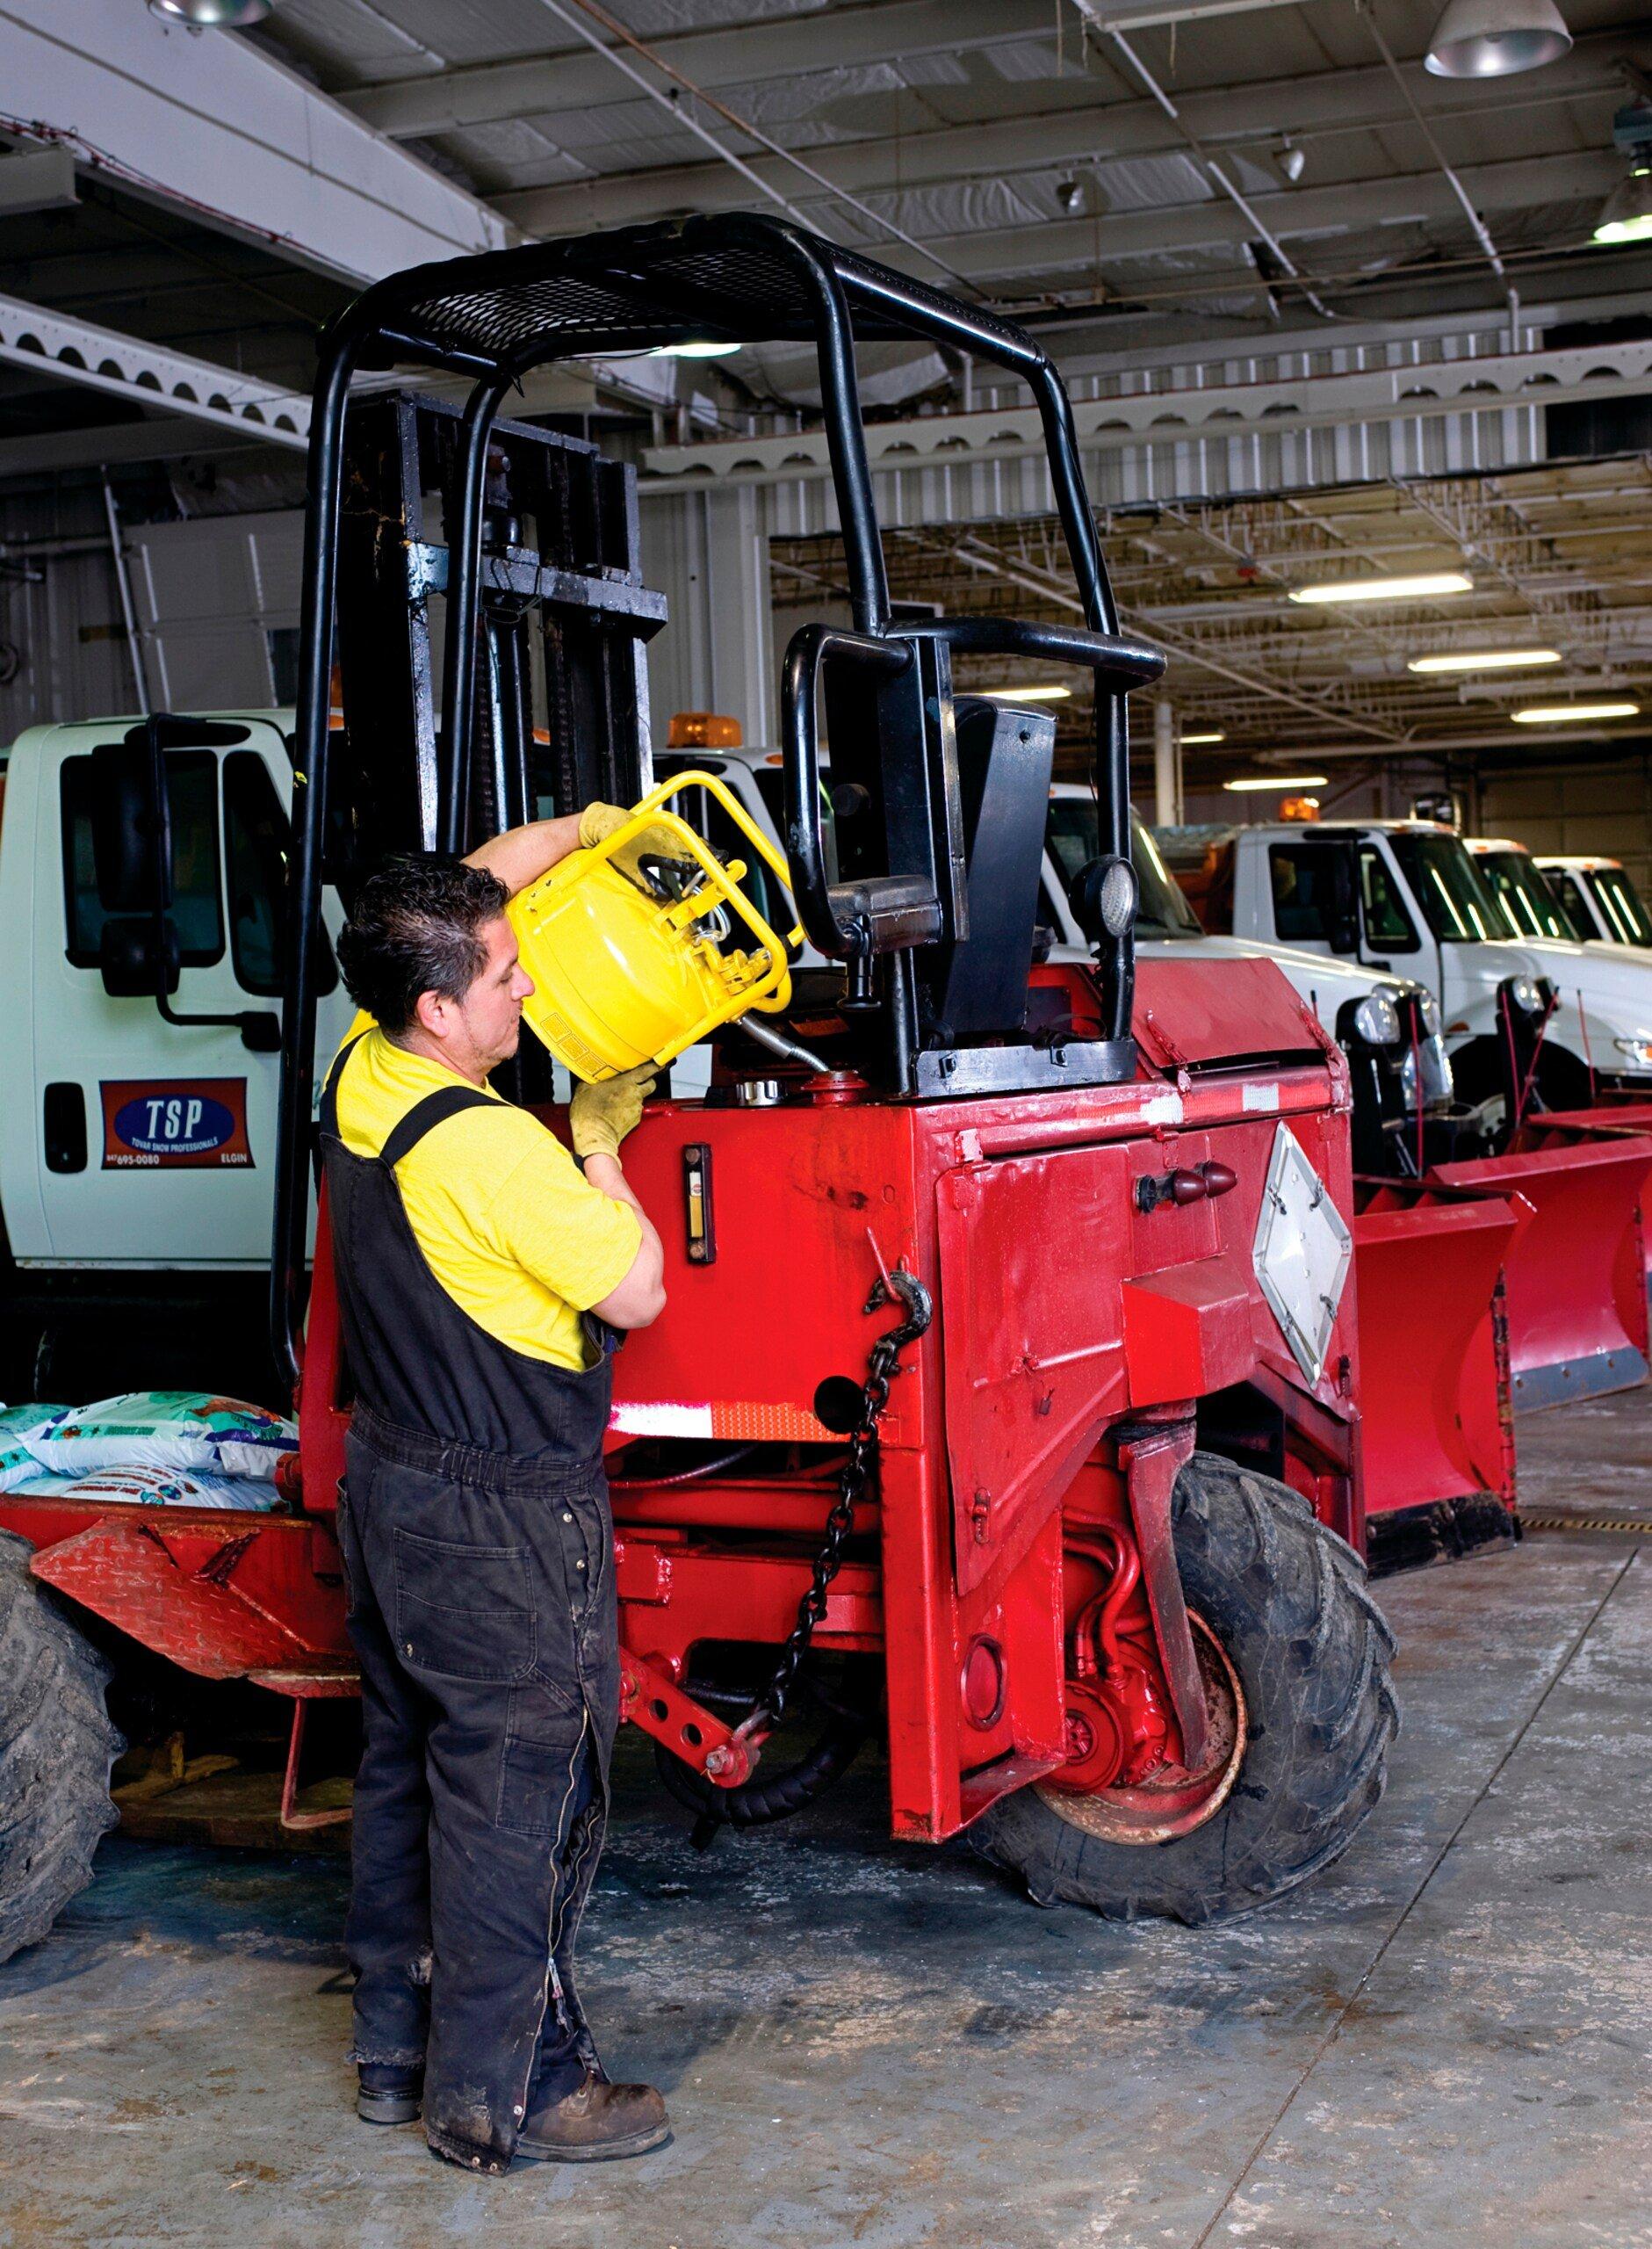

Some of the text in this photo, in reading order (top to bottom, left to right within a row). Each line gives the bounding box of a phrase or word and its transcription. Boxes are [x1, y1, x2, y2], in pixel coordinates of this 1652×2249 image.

[146, 1099, 203, 1139] TSP
[170, 1136, 219, 1153] PROFESSIONALS
[220, 1153, 248, 1164] ELGIN
